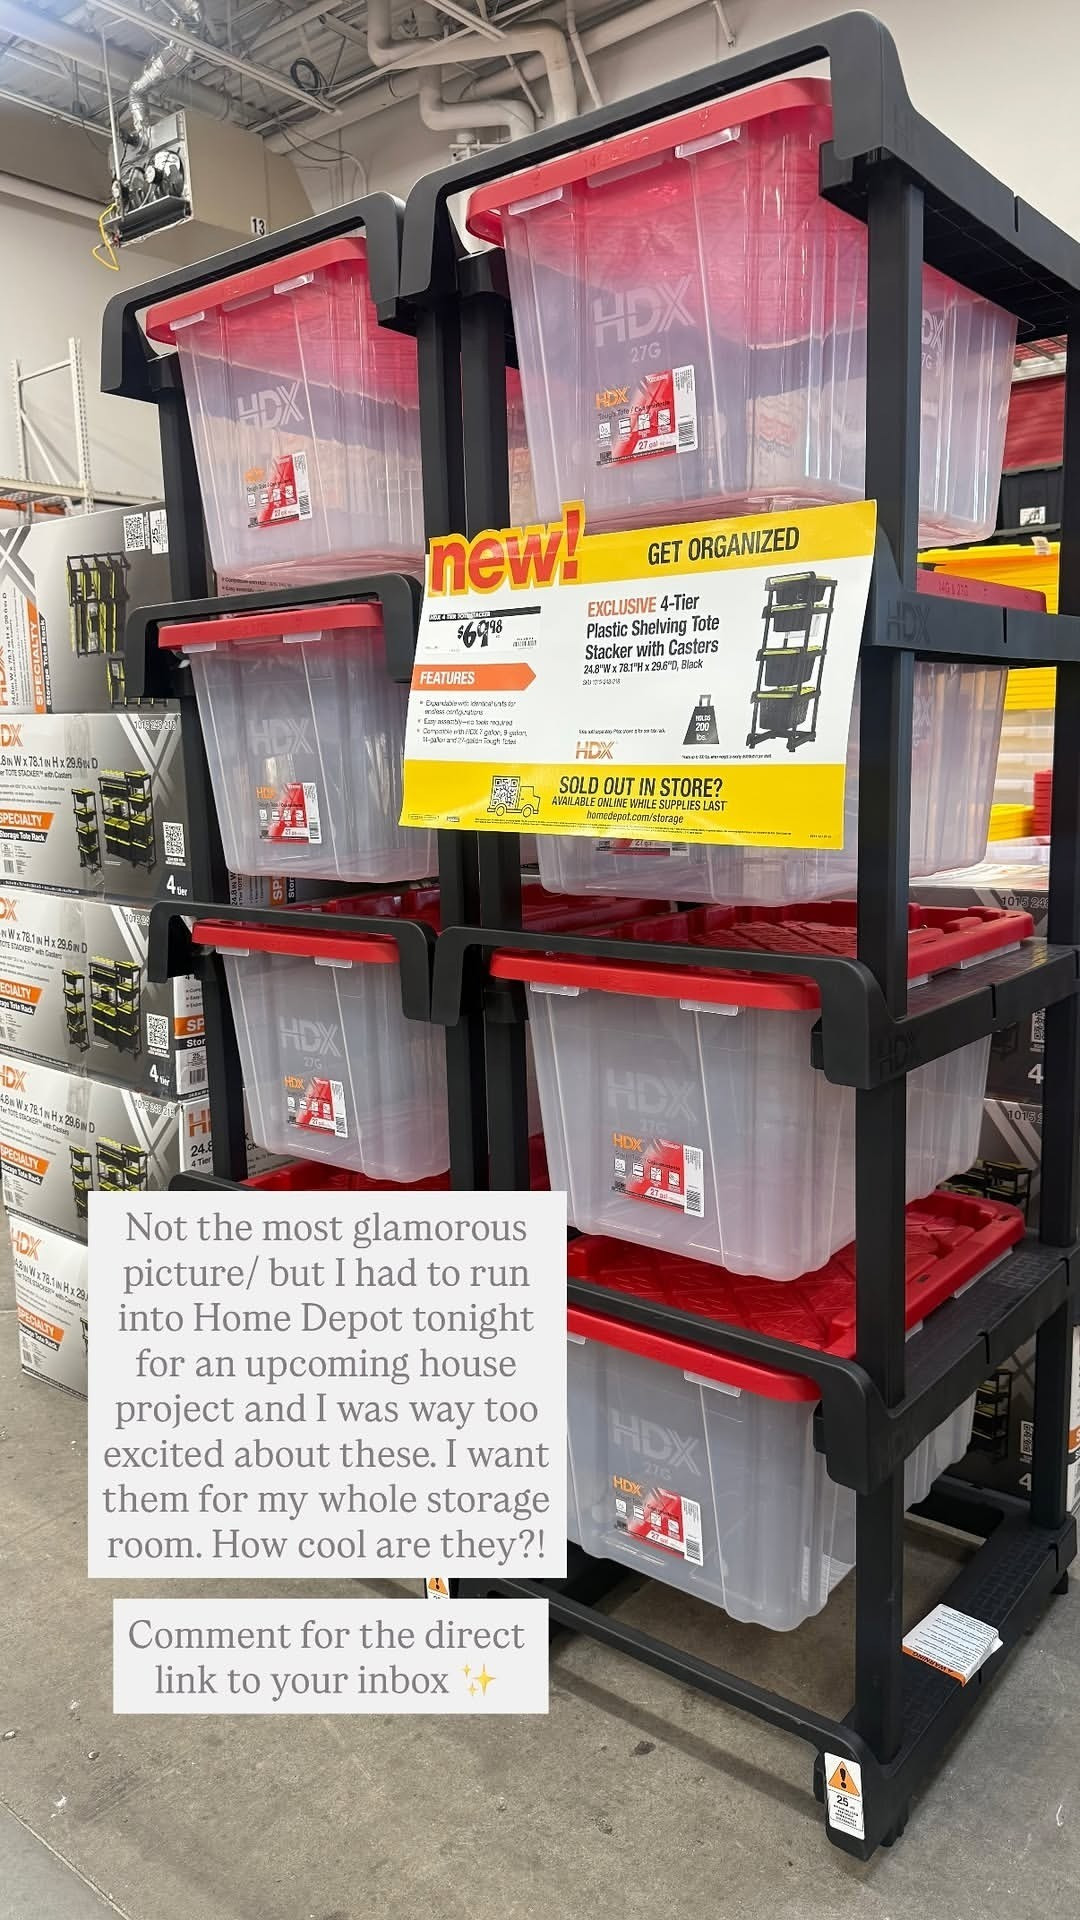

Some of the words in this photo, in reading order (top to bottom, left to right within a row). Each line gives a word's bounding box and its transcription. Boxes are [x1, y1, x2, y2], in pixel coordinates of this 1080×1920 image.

[252, 218, 265, 235] 13
[593, 274, 696, 347] HDX
[631, 343, 661, 363] 27G
[237, 382, 304, 429] HDX
[596, 386, 629, 408] HDX
[431, 510, 581, 591] new!
[648, 538, 686, 565] GET
[688, 527, 800, 562] ORGANIZED
[587, 597, 657, 617] EXCLUSIVE
[660, 593, 700, 611] 4-Tier
[586, 621, 628, 639] Plastic
[631, 617, 688, 637] Shelving
[692, 615, 720, 632] Tote
[585, 643, 633, 660] Stacker
[636, 641, 665, 658] with
[668, 639, 719, 656] Casters
[30, 621, 44, 706] SPECIALTY
[681, 658, 704, 670] Black
[420, 671, 475, 685] FEATURES
[695, 722, 710, 732] 200
[14, 755, 21, 766] W
[29, 756, 43, 767] 78.1
[52, 756, 58, 768] H
[92, 757, 98, 769] D
[559, 776, 599, 795] SOLD
[604, 777, 636, 796] OUT
[638, 777, 656, 796] IN
[660, 777, 723, 798] STORE?
[551, 796, 596, 807] AVAILABLE
[597, 797, 629, 808] ONLINE
[630, 798, 657, 809] WHILE
[659, 799, 701, 811] SUPPLIES
[703, 800, 726, 811] LAST
[586, 810, 684, 824] homedepot.com/storage
[166, 874, 176, 895] 4
[177, 885, 188, 897] tier
[1001, 895, 1028, 907] 1015
[22, 931, 35, 944] 78.1
[187, 1039, 206, 1048] Stor
[279, 1015, 340, 1057] HDX
[150, 1064, 159, 1082] 4
[1028, 1063, 1044, 1085] 4
[30, 1103, 43, 1118] 78.1
[65, 1114, 81, 1130] 29.6
[1008, 1109, 1035, 1123] 1015
[612, 1133, 643, 1152] HDX
[1, 1147, 39, 1170] SPECIALTY
[10, 1227, 43, 1261] HDX
[610, 1408, 700, 1475] HDX
[612, 1474, 642, 1497] HDX
[1018, 1472, 1032, 1492] 4
[836, 1794, 849, 1807] 25
